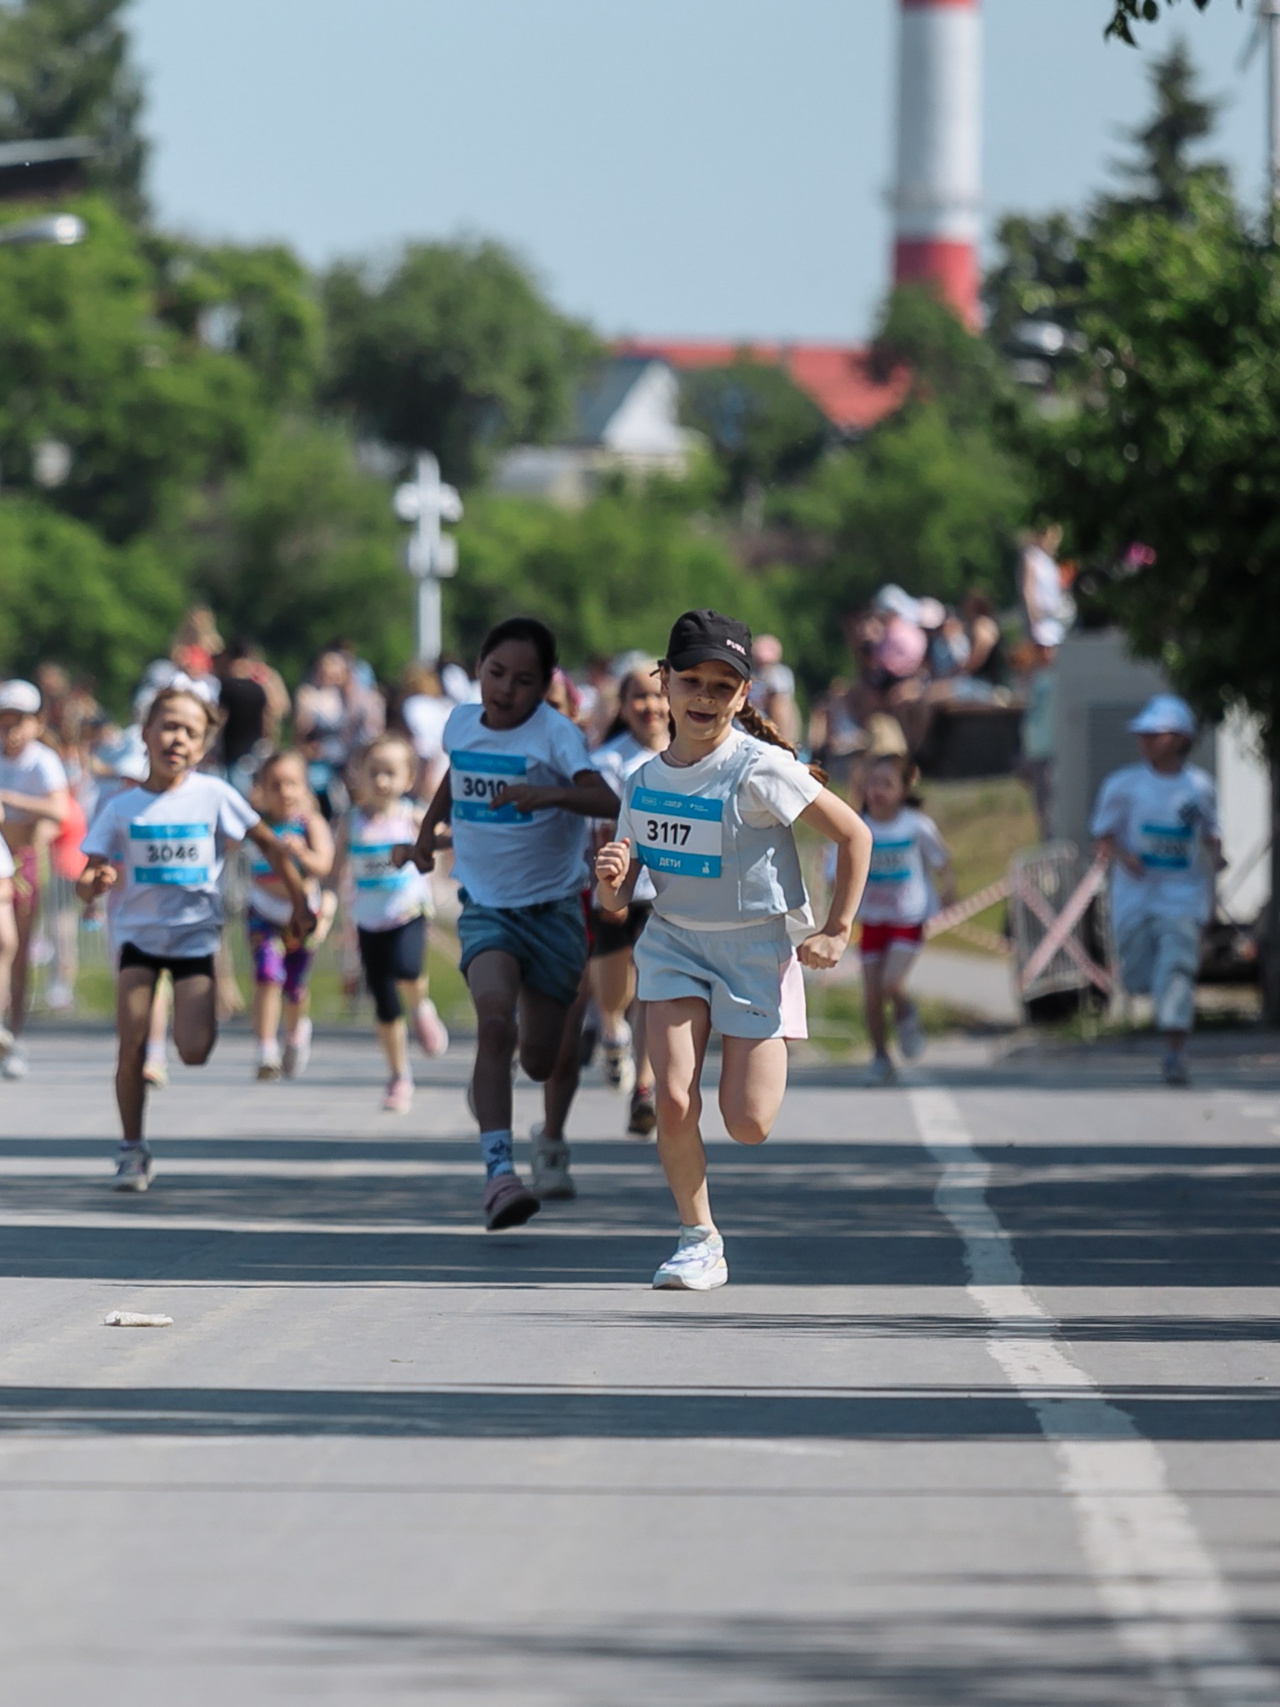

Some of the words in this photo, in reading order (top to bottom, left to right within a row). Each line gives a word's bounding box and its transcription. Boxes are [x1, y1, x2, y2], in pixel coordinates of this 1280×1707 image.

[646, 820, 692, 846] 3117
[148, 845, 199, 863] 3046
[659, 857, 681, 868] ДЕТИ
